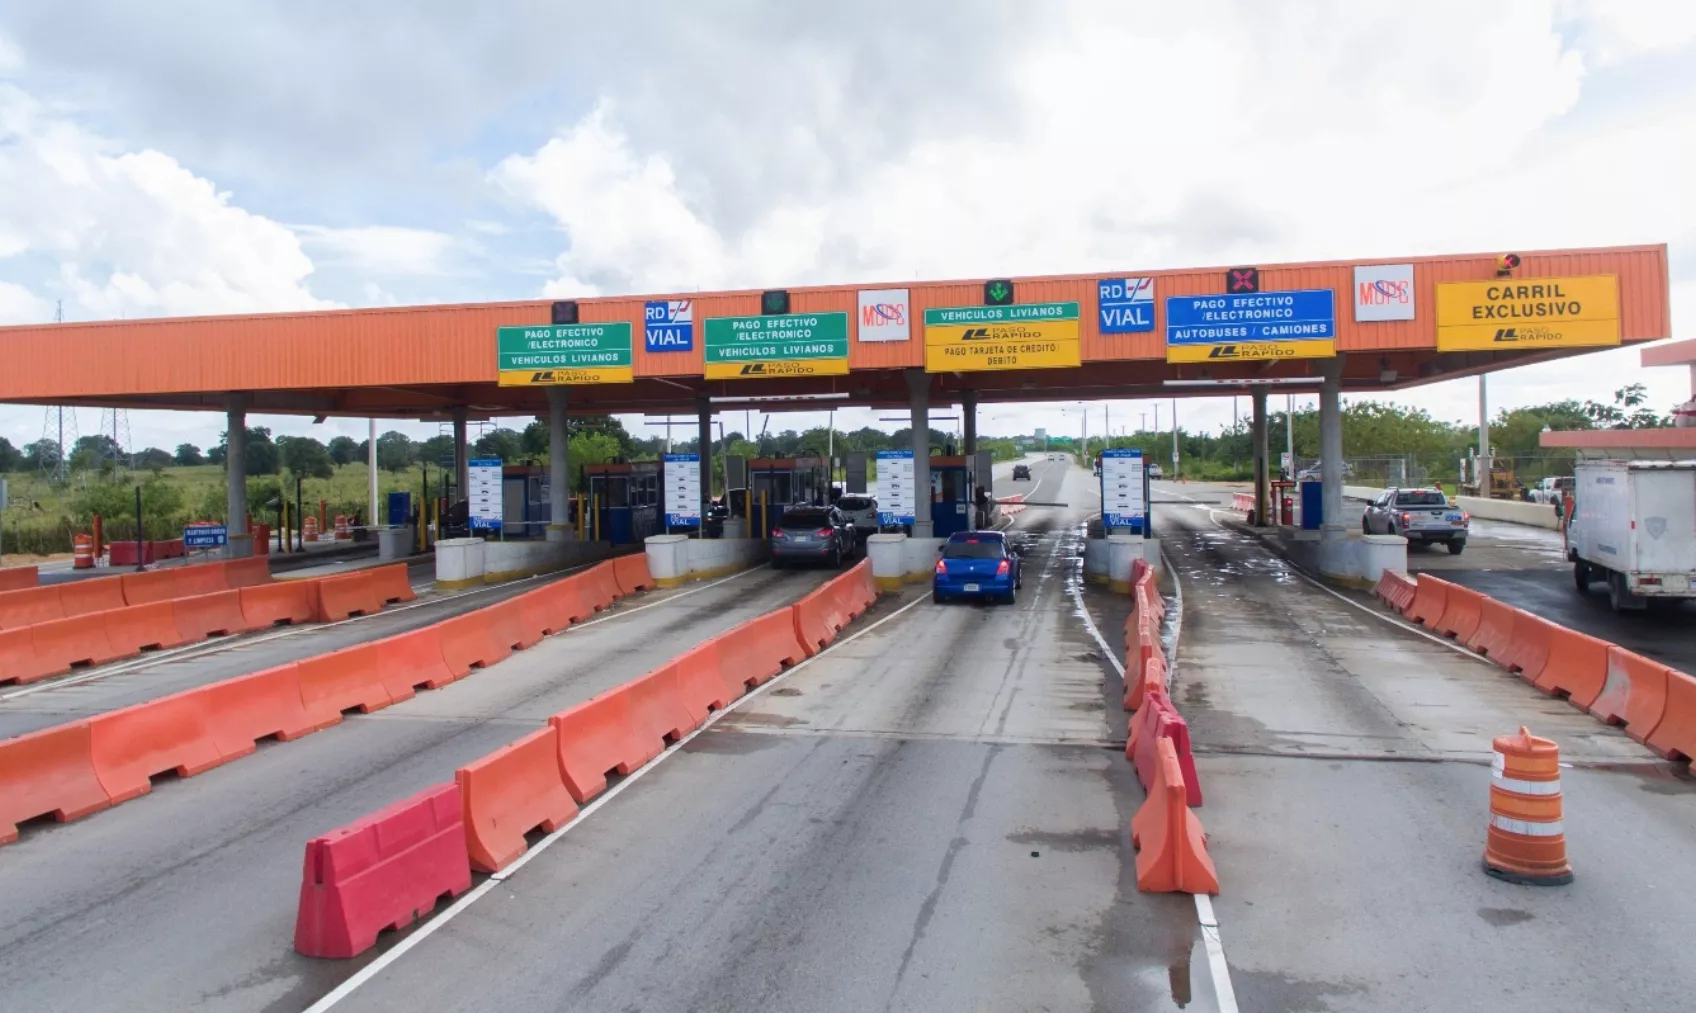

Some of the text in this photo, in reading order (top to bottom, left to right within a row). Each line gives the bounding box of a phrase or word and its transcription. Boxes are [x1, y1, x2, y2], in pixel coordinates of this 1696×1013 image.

[1100, 285, 1122, 299] RD
[1487, 284, 1566, 301] CARRIL
[1193, 296, 1294, 310] PAGO EFECTIVO
[1472, 301, 1581, 319] EXCLUSIVO
[646, 306, 665, 320] RD
[941, 306, 1063, 321] VEHICULOS LIVIANOS
[1101, 308, 1149, 327] VIAL
[733, 318, 818, 330] PAGO EFECTIVO
[1175, 326, 1247, 339] AUTOBUSES
[1262, 323, 1327, 337] CAMIONES
[525, 328, 604, 339] PAGO EFECTIVO
[646, 328, 688, 346] VIAL
[719, 344, 834, 357] VEHICULOS LIVIANOS
[945, 347, 966, 356] PAGO
[969, 346, 1005, 355] TARJETA
[1007, 345, 1018, 354] DE
[511, 353, 619, 365] VEHICULOS LIVIANOS
[988, 356, 1017, 366] DEBITO
